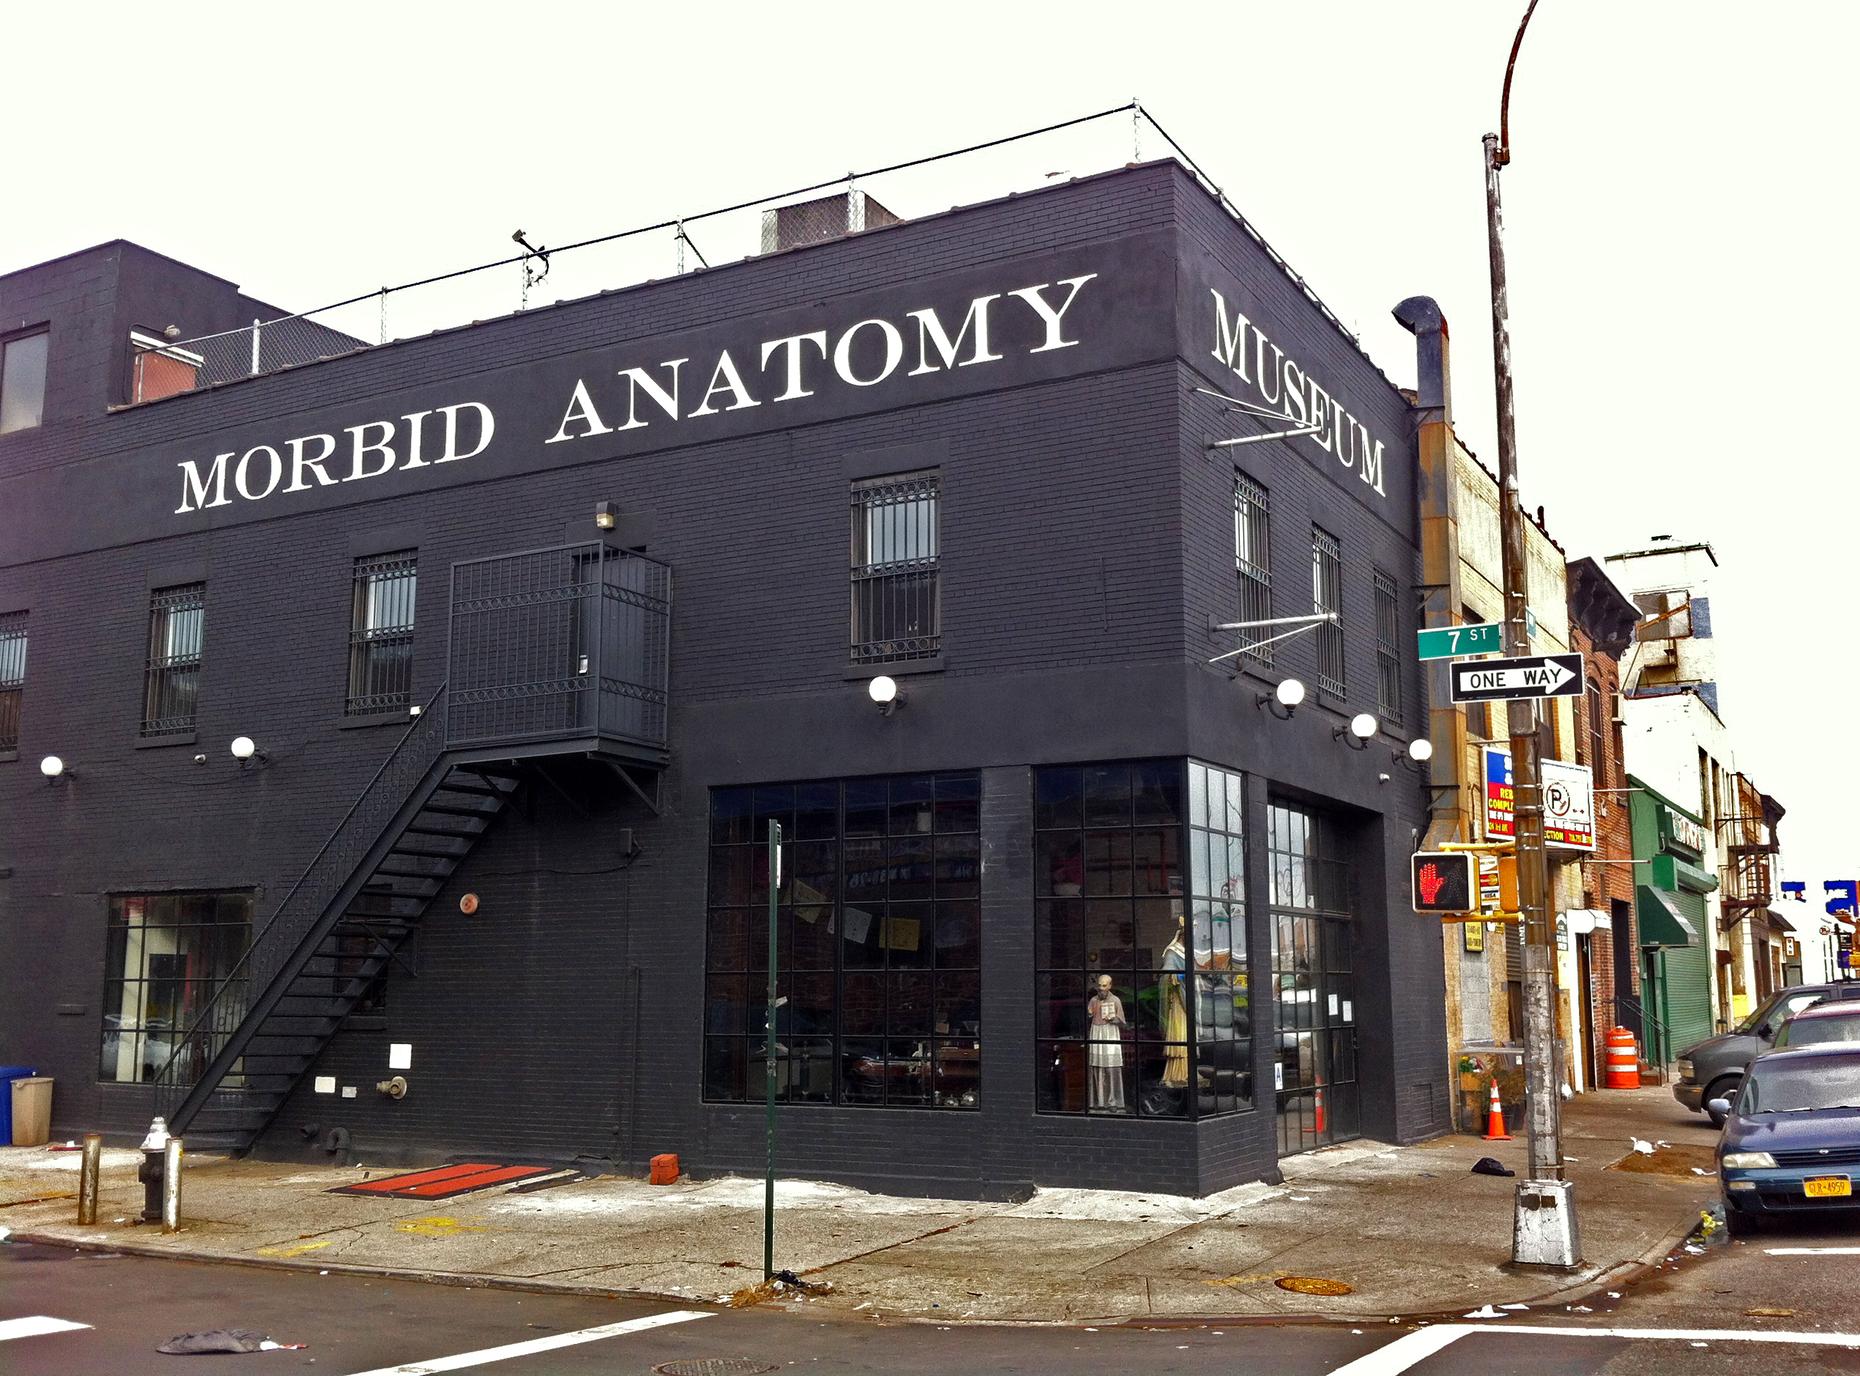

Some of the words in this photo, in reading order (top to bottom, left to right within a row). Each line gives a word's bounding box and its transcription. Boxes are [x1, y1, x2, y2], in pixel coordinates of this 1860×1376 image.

[174, 402, 495, 514] MORBID
[544, 273, 1098, 444] ANATOMY
[1210, 288, 1386, 498] MUSEUM
[1448, 631, 1460, 653] 7
[1469, 627, 1488, 641] ST
[1470, 671, 1507, 689] ONE
[1523, 668, 1562, 685] WAY
